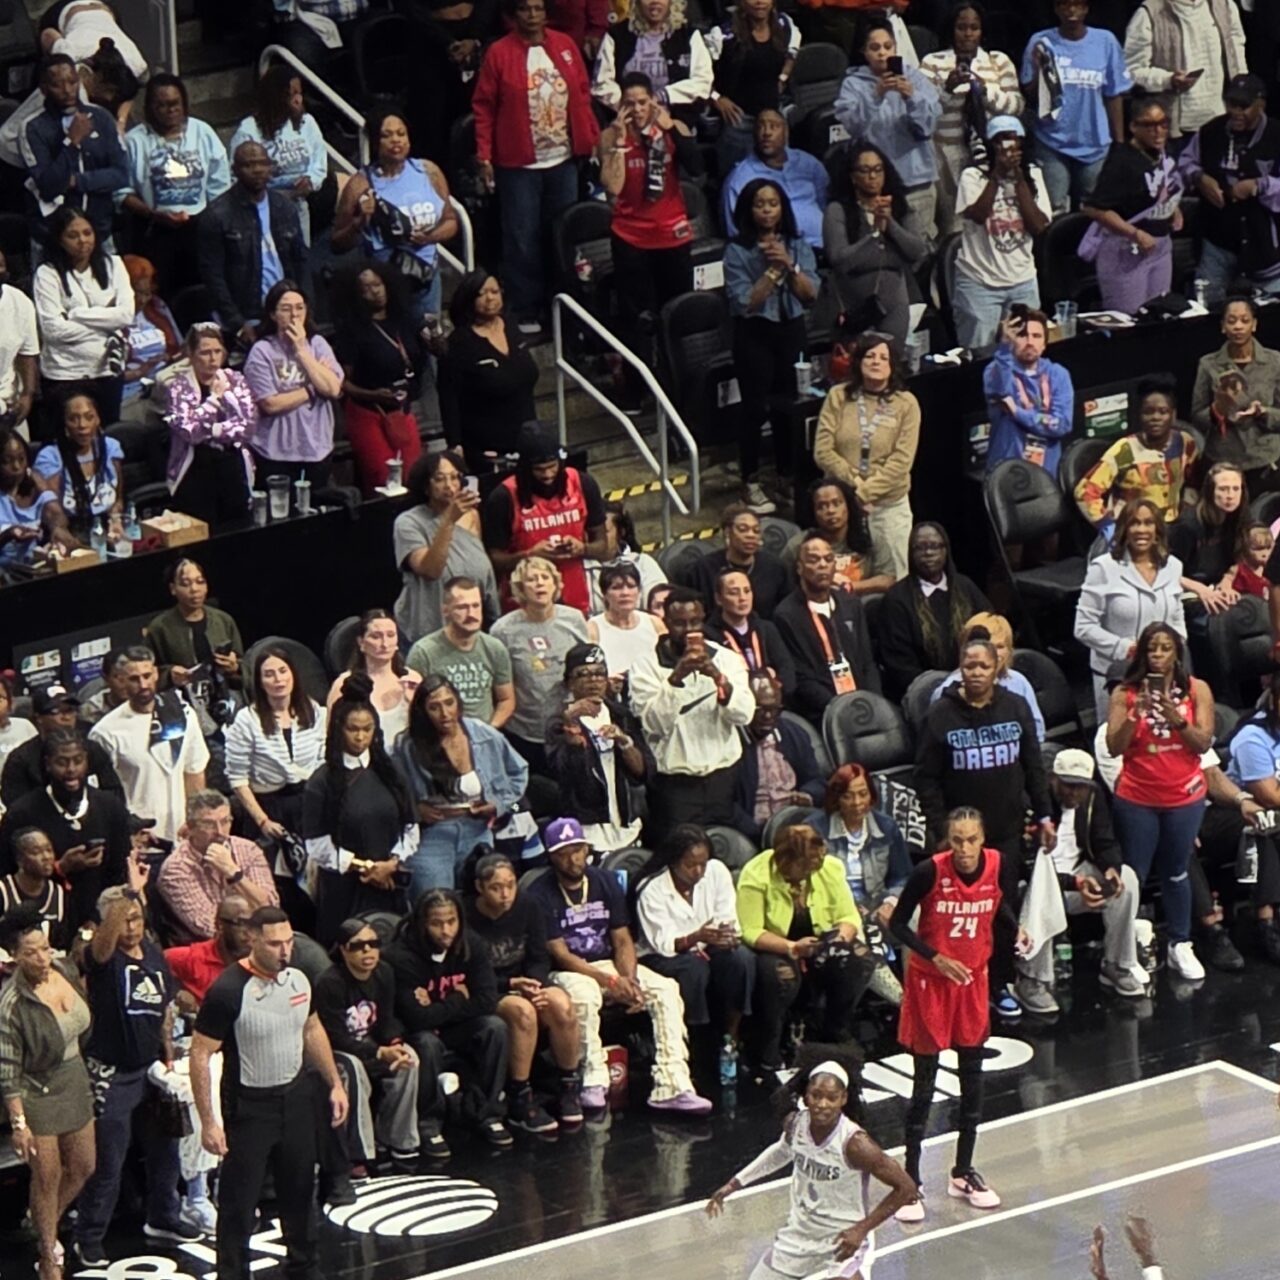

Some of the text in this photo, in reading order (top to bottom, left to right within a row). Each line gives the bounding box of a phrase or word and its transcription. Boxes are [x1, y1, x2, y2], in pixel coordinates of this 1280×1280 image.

[523, 508, 581, 532] ATLANTA
[948, 721, 1023, 749] ATLANTA
[952, 741, 1020, 770] DREAM
[936, 898, 994, 915] ATLANTA
[949, 916, 979, 939] 24
